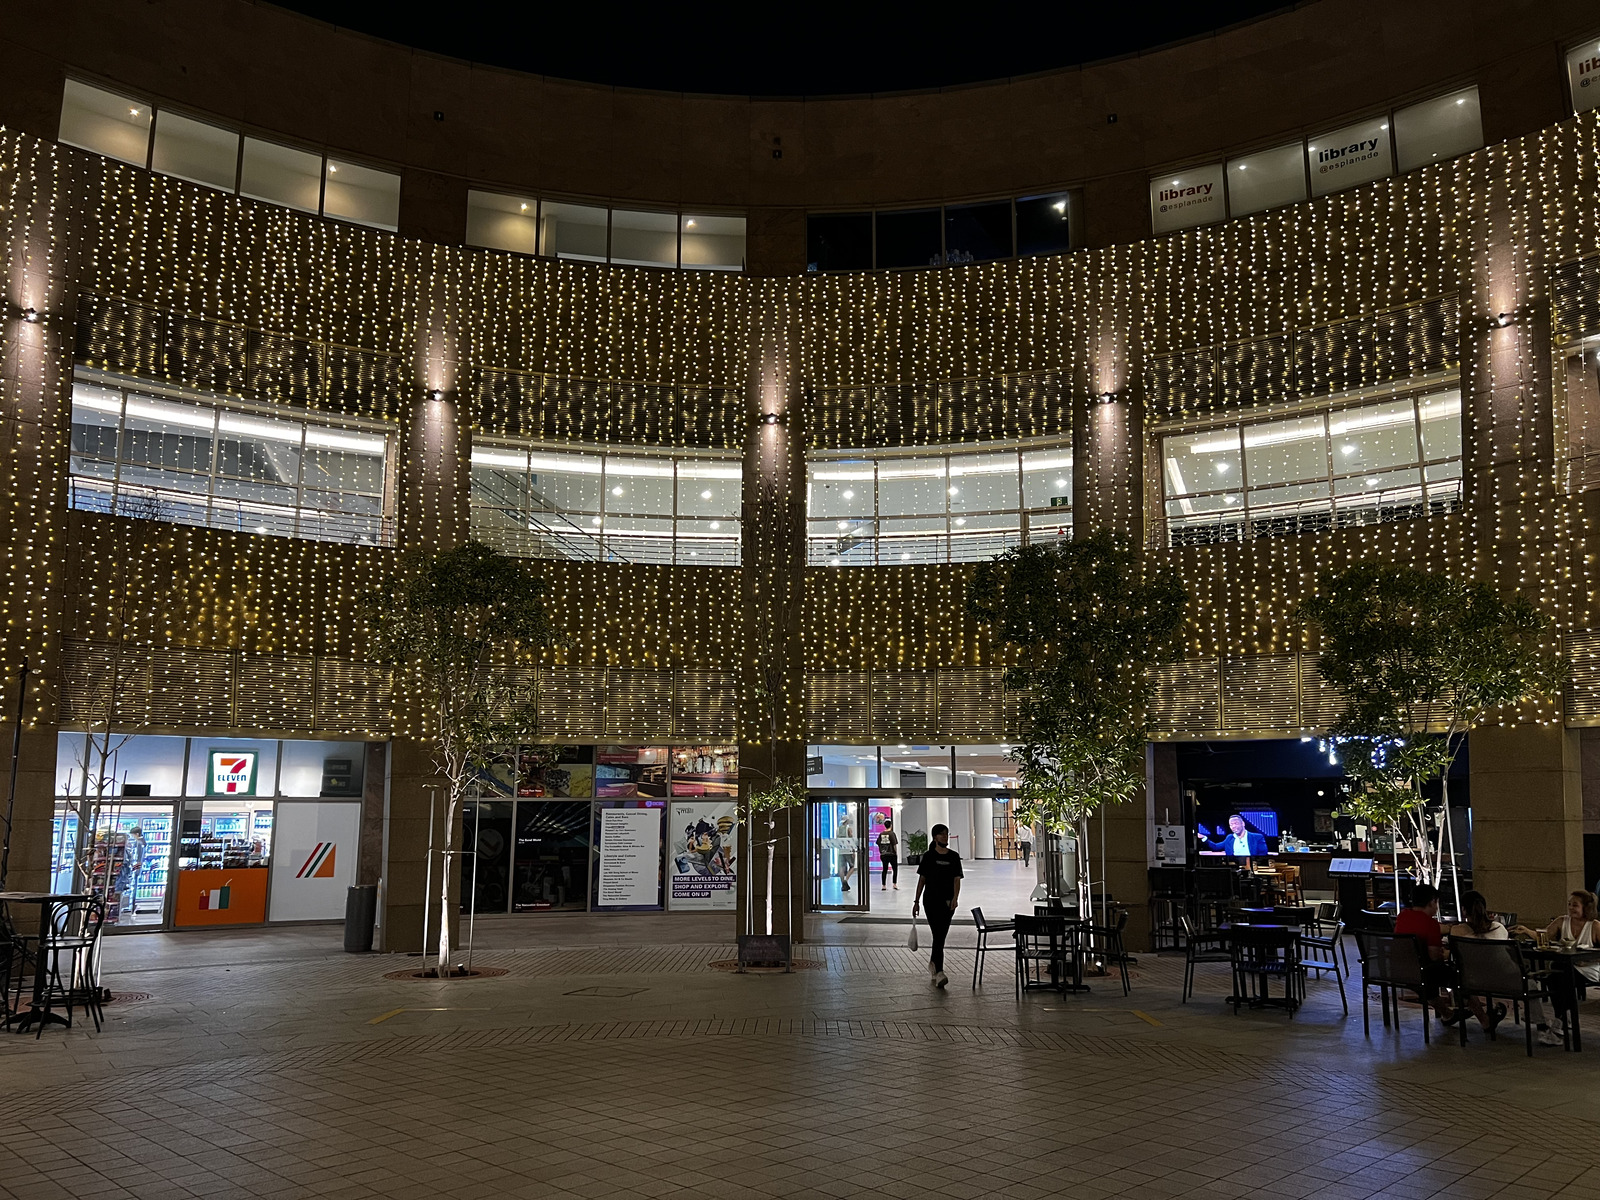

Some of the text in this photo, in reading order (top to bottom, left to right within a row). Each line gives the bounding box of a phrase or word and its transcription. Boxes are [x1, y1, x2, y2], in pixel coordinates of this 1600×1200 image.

[1318, 137, 1379, 164] library
[1319, 150, 1379, 174] @esplanade
[1159, 181, 1213, 202] library
[1159, 196, 1213, 213] @esplanade
[220, 758, 247, 792] 7
